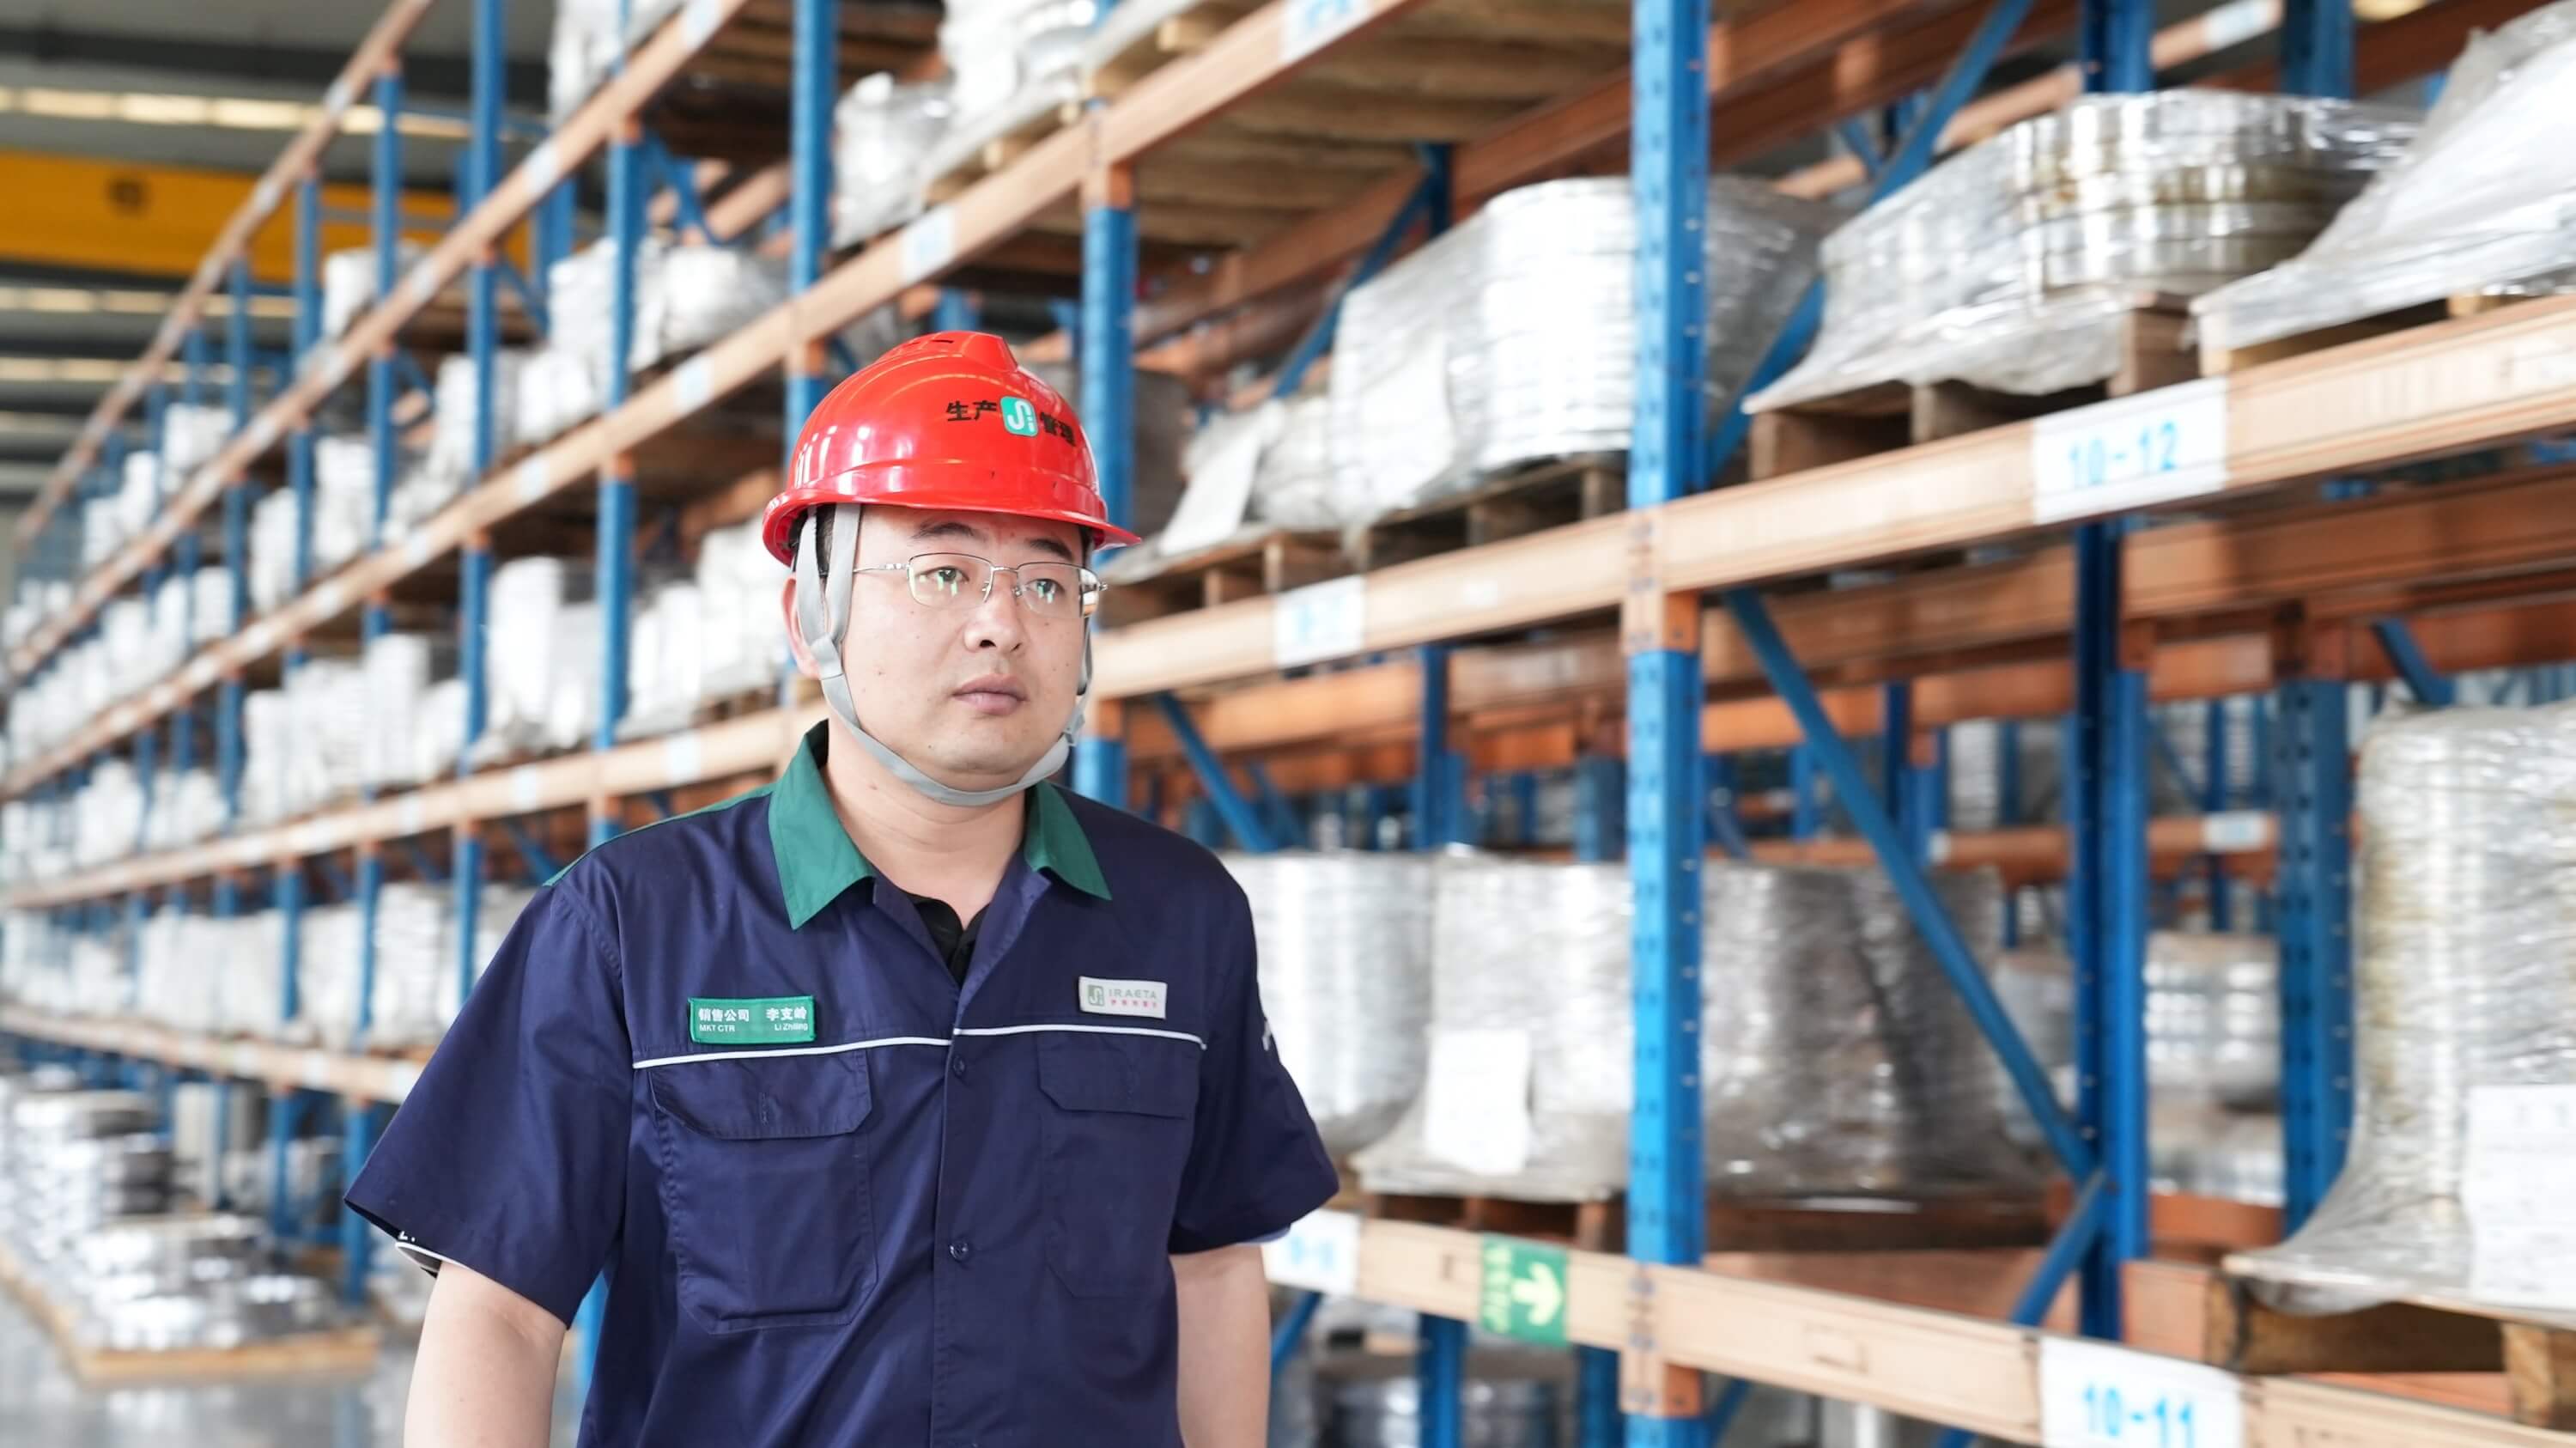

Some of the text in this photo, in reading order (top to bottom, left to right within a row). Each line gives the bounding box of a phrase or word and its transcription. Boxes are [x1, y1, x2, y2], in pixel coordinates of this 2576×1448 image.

[946, 399, 998, 422] 生产
[2068, 419, 2180, 490] 10-12
[698, 1007, 750, 1022] 销售公司
[2081, 1381, 2196, 1448] 10-11
